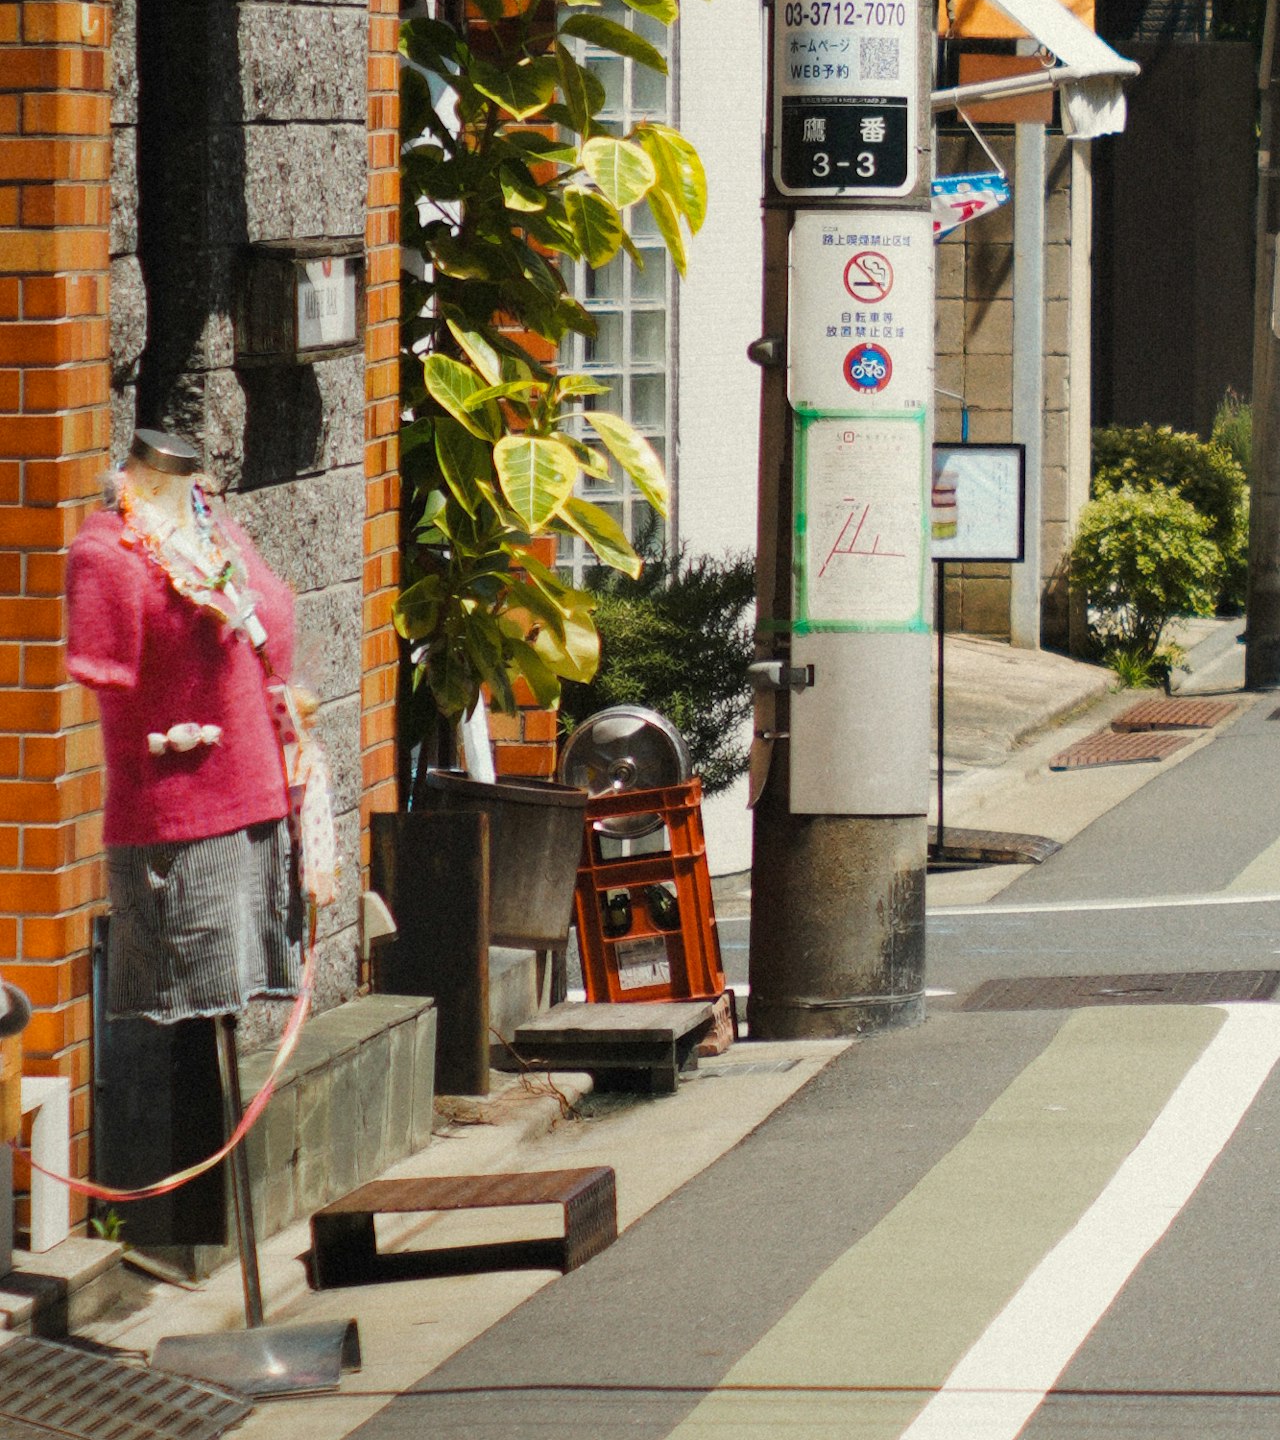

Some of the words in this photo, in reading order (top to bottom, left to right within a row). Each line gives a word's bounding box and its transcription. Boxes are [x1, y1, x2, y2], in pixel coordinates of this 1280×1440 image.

[785, 1, 906, 27] 03-3712-7070
[790, 38, 850, 54] ホームページ
[790, 63, 850, 80] WEB予約
[811, 152, 876, 178] 3-3
